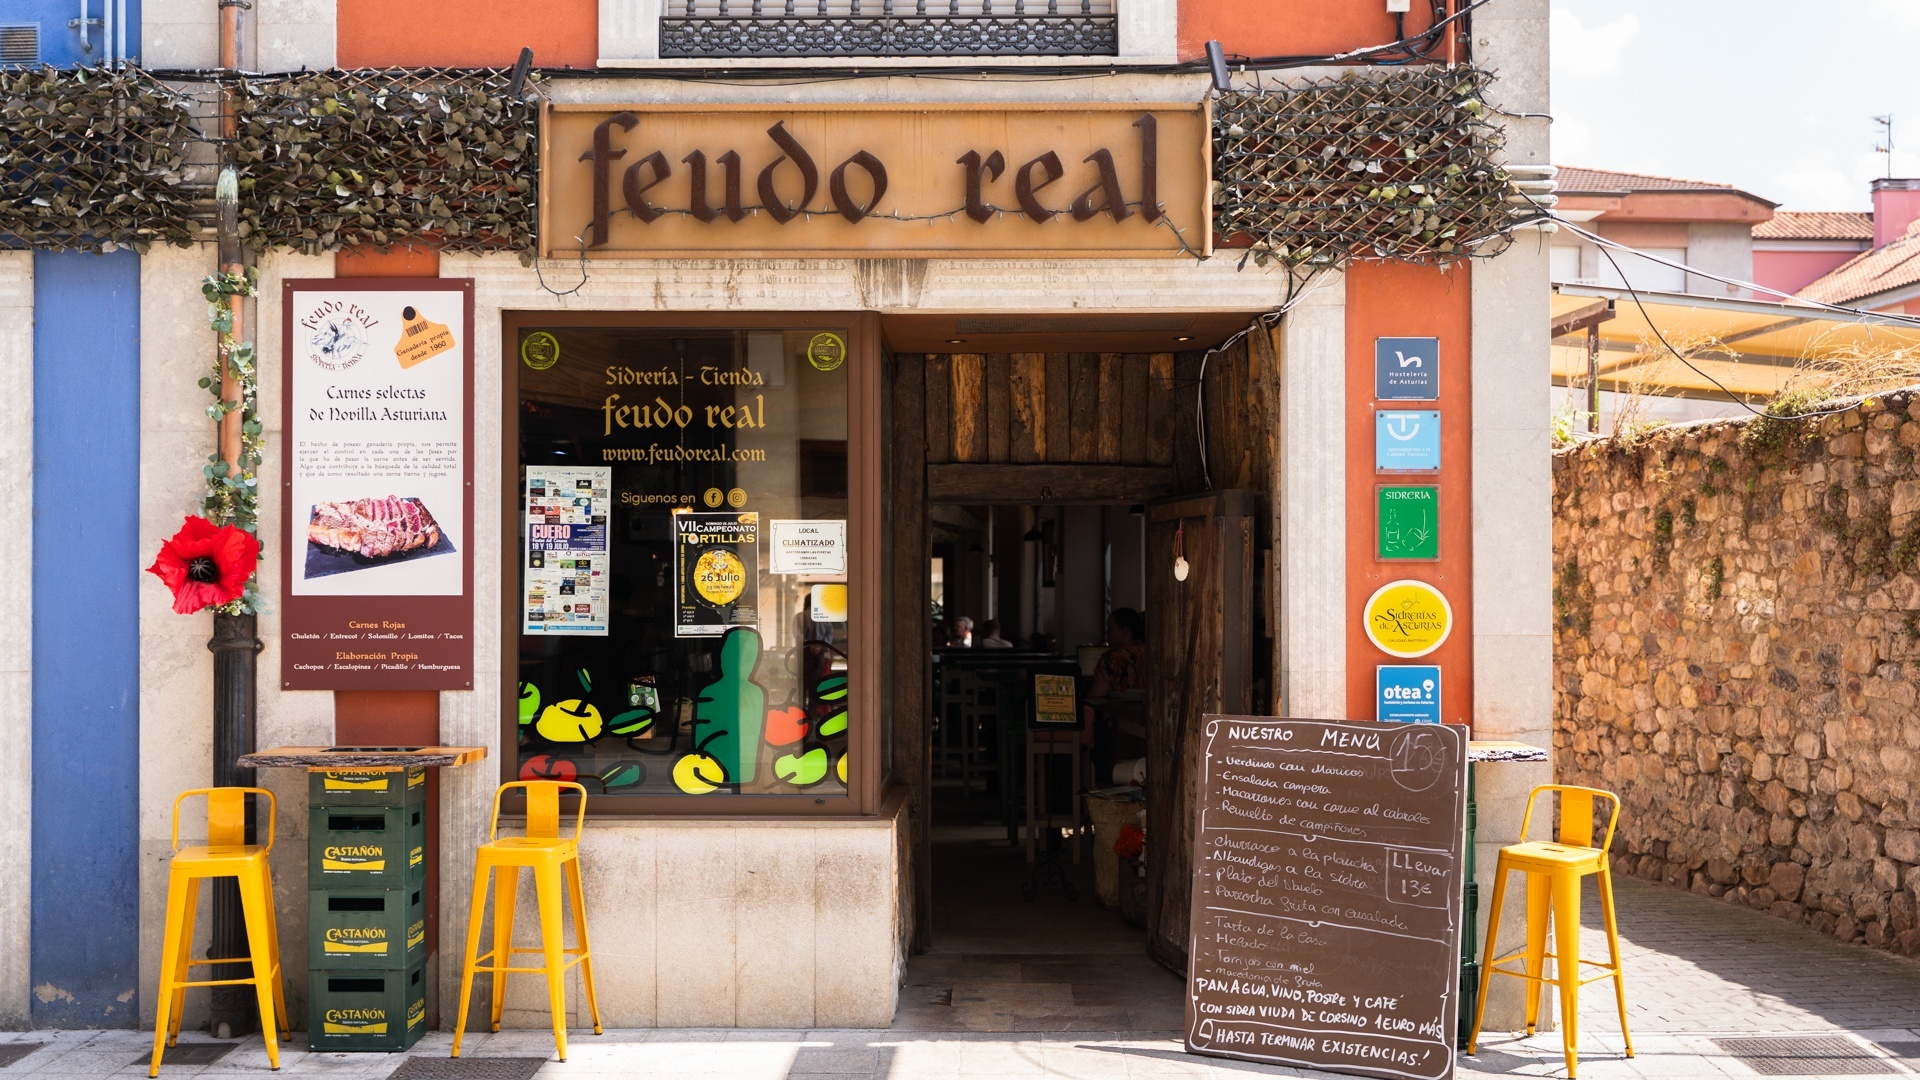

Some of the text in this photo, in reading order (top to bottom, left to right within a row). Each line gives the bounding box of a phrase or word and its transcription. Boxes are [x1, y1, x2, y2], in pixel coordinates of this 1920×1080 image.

[578, 111, 1166, 249] feudo real
[301, 301, 379, 330] feudo real
[396, 330, 450, 357] Ganadería propia
[410, 340, 447, 361] desde 1960
[605, 366, 764, 385] Sidrería Tienda
[326, 385, 426, 400] Carnes selectas
[309, 407, 448, 421] de Novilla Asturiana
[601, 393, 766, 436] feudo real
[602, 443, 766, 465] www.feudoreal.com
[621, 492, 696, 505] Siguenos en
[532, 524, 571, 539] CUERO
[678, 520, 756, 533] VII CAMPEONATO
[701, 572, 740, 582] 26 Julio
[348, 620, 406, 631] Carnes Rojas
[336, 652, 418, 661] Elaboración Propia
[293, 663, 324, 671] Cachopos
[334, 663, 371, 671] Escalopines
[418, 663, 461, 671] Hamburguesa
[1228, 725, 1380, 751] NUESTRO MENÚ
[1222, 770, 1332, 794] Ensalada campera
[1222, 786, 1292, 806] Macarrones
[1363, 803, 1380, 817] al
[1383, 807, 1431, 825] cabrales
[1279, 814, 1297, 826] de
[324, 844, 383, 860] CASTAÑÓN
[1288, 847, 1298, 857] a
[1215, 864, 1256, 884] Plato
[1257, 875, 1279, 888] del
[1285, 865, 1298, 875] a
[1401, 879, 1432, 898] 13€
[1321, 904, 1341, 916] con
[1214, 915, 1252, 933] Tarta
[1257, 924, 1275, 935] de
[325, 926, 386, 941] CASTAÑÓN
[1216, 933, 1268, 950] Helado
[1289, 962, 1315, 974] miel
[1274, 975, 1289, 985] de
[1353, 995, 1360, 1008] Y
[325, 1007, 386, 1023] CASTAÑÓN
[1199, 1002, 1223, 1014] CON
[1225, 1004, 1256, 1016] SIDRA
[1259, 1005, 1296, 1020] VIUDA
[1301, 1008, 1316, 1022] DE
[1319, 1010, 1368, 1028] CORSINO
[1418, 1016, 1443, 1039] MÁS
[1216, 1028, 1255, 1044] HASTA
[1260, 1032, 1316, 1052] TERMINAR
